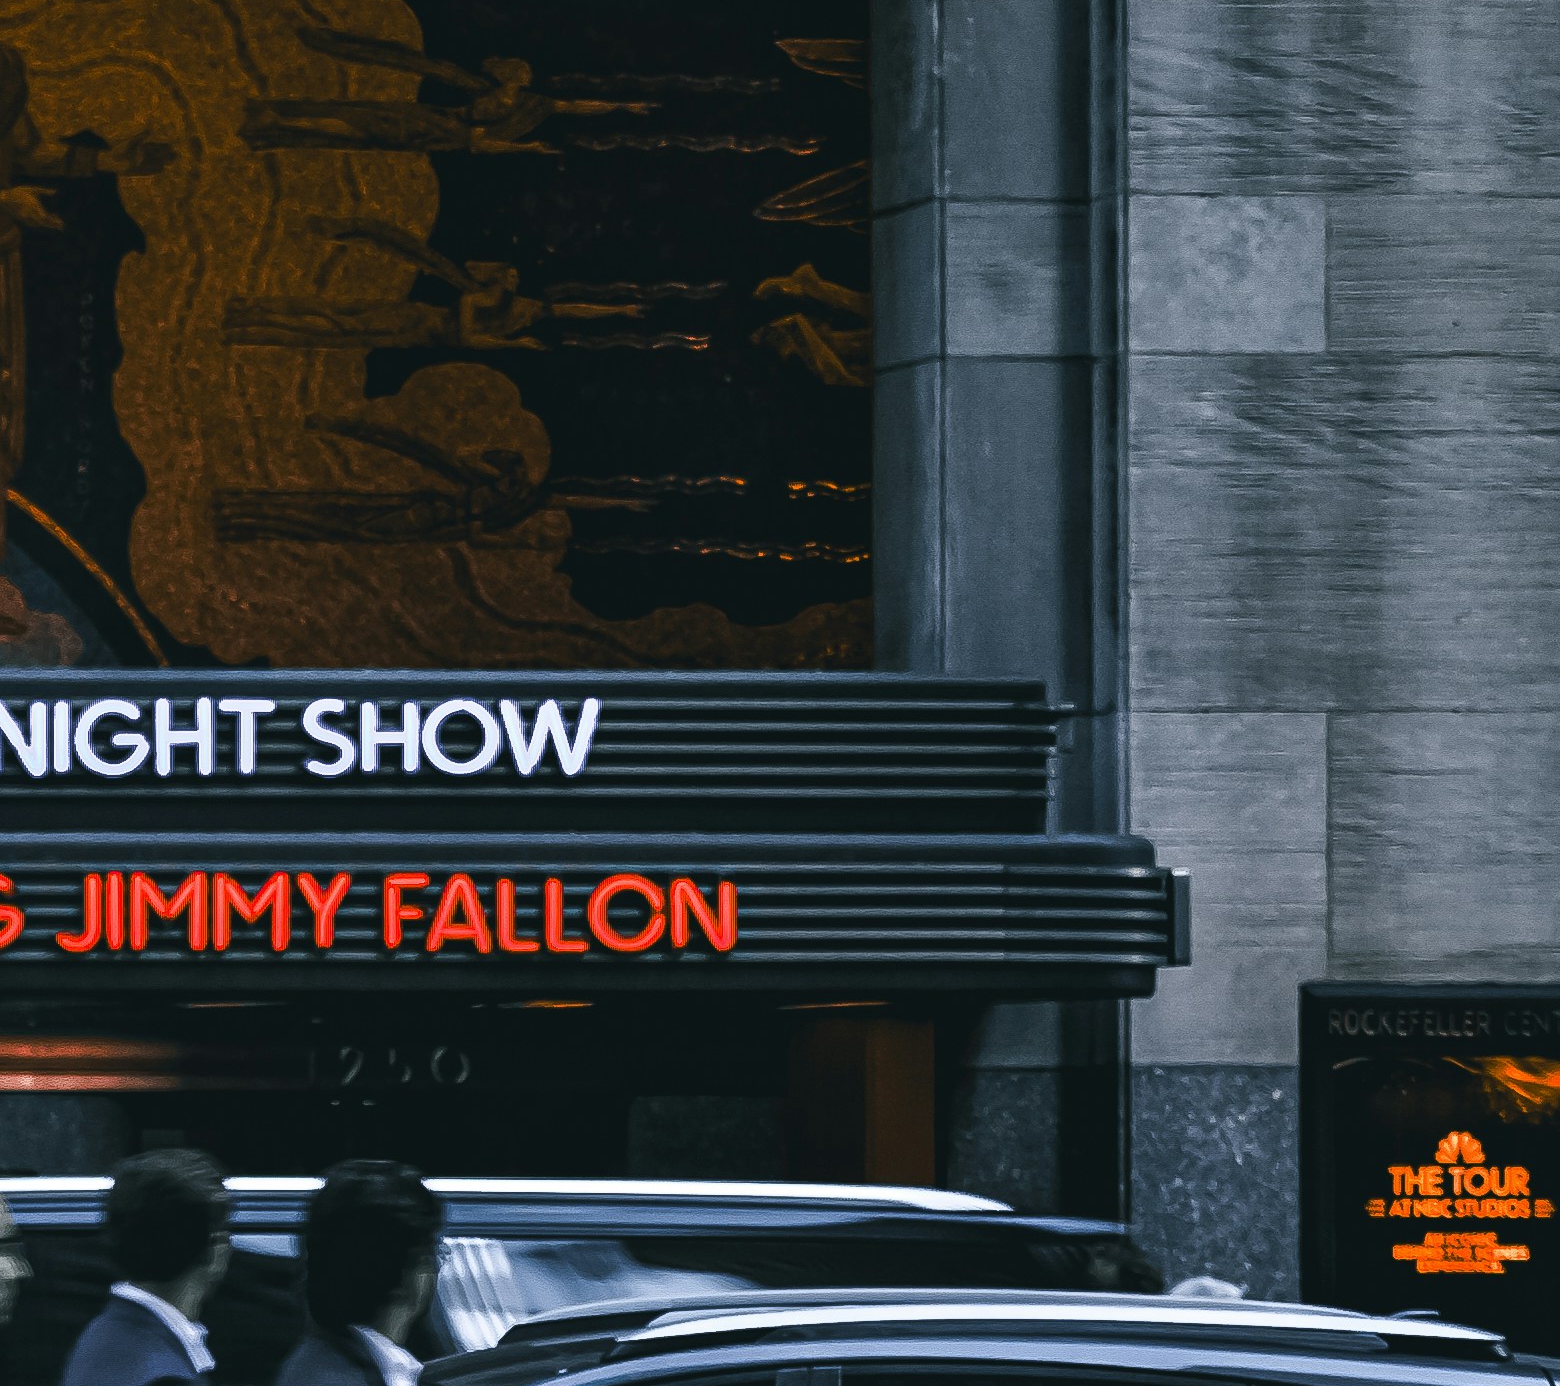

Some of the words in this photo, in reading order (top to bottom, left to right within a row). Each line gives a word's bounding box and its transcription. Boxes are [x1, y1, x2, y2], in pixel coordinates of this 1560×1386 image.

[301, 696, 602, 776] SHOW
[54, 870, 351, 952] JIMMY
[382, 871, 738, 953] FALLON
[1327, 1008, 1492, 1038] ROCKEFELLER
[1388, 1165, 1444, 1196] THE
[1448, 1165, 1531, 1197] TOUR
[1389, 1198, 1412, 1218] AT
[1453, 1198, 1531, 1218] STUDIOS
